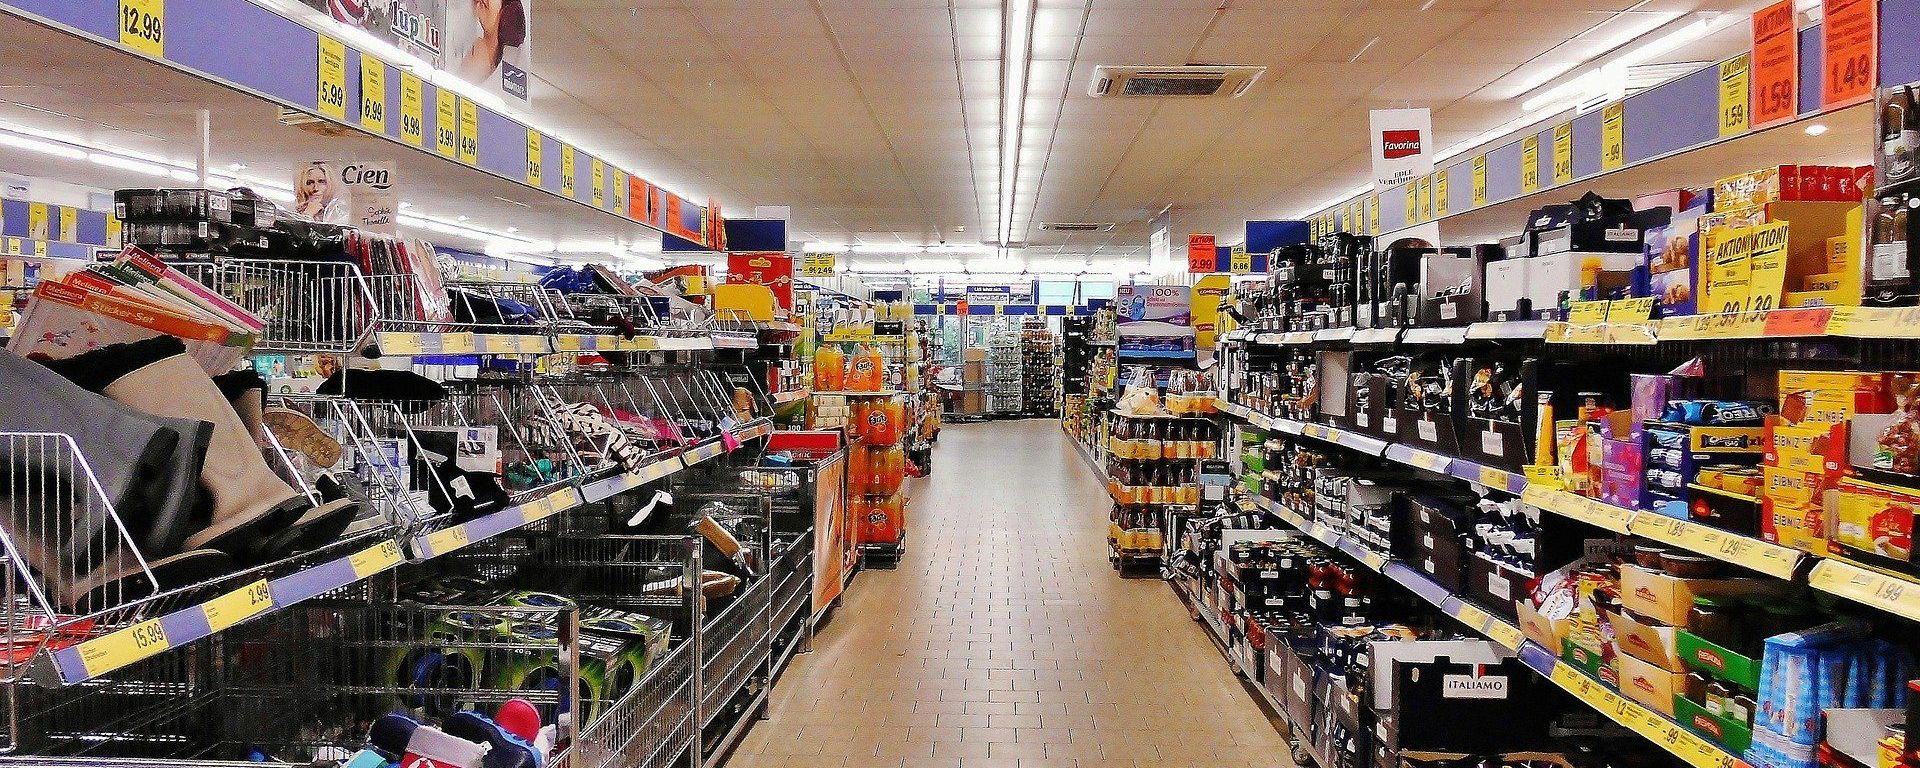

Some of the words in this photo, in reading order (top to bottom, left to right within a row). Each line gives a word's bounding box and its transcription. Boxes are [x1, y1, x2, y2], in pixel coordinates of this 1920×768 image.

[123, 4, 162, 43] 12.99
[391, 0, 440, 49] lupilu
[1830, 54, 1870, 94] 1.49
[321, 80, 344, 108] 5.99
[364, 97, 383, 122] 6.99
[1724, 104, 1744, 128] 1.59
[403, 114, 421, 137] 9.99
[439, 126, 455, 148] 3.99
[461, 136, 476, 156] 4.99
[1384, 140, 1420, 150] Favorina
[1605, 142, 1620, 161] -.99
[341, 164, 389, 185] Cien
[1394, 169, 1413, 178] EDLE
[817, 266, 832, 274] 2.49
[1191, 259, 1213, 270] 2.99
[1151, 288, 1180, 297] 100%
[91, 302, 156, 324] Sticker-Set
[1742, 295, 1773, 323] 1.39
[855, 361, 874, 373] Fanta
[788, 424, 801, 432] 100
[868, 413, 887, 425] Fanta
[868, 512, 887, 525] Fanta
[380, 537, 398, 558] 9.99
[1719, 537, 1741, 556] 1.29
[248, 582, 270, 606] 2.99
[1875, 580, 1905, 601] 1.99
[132, 622, 165, 649] 15.99
[1449, 680, 1502, 690] ITALIAMO
[1662, 727, 1679, 745] -.99
